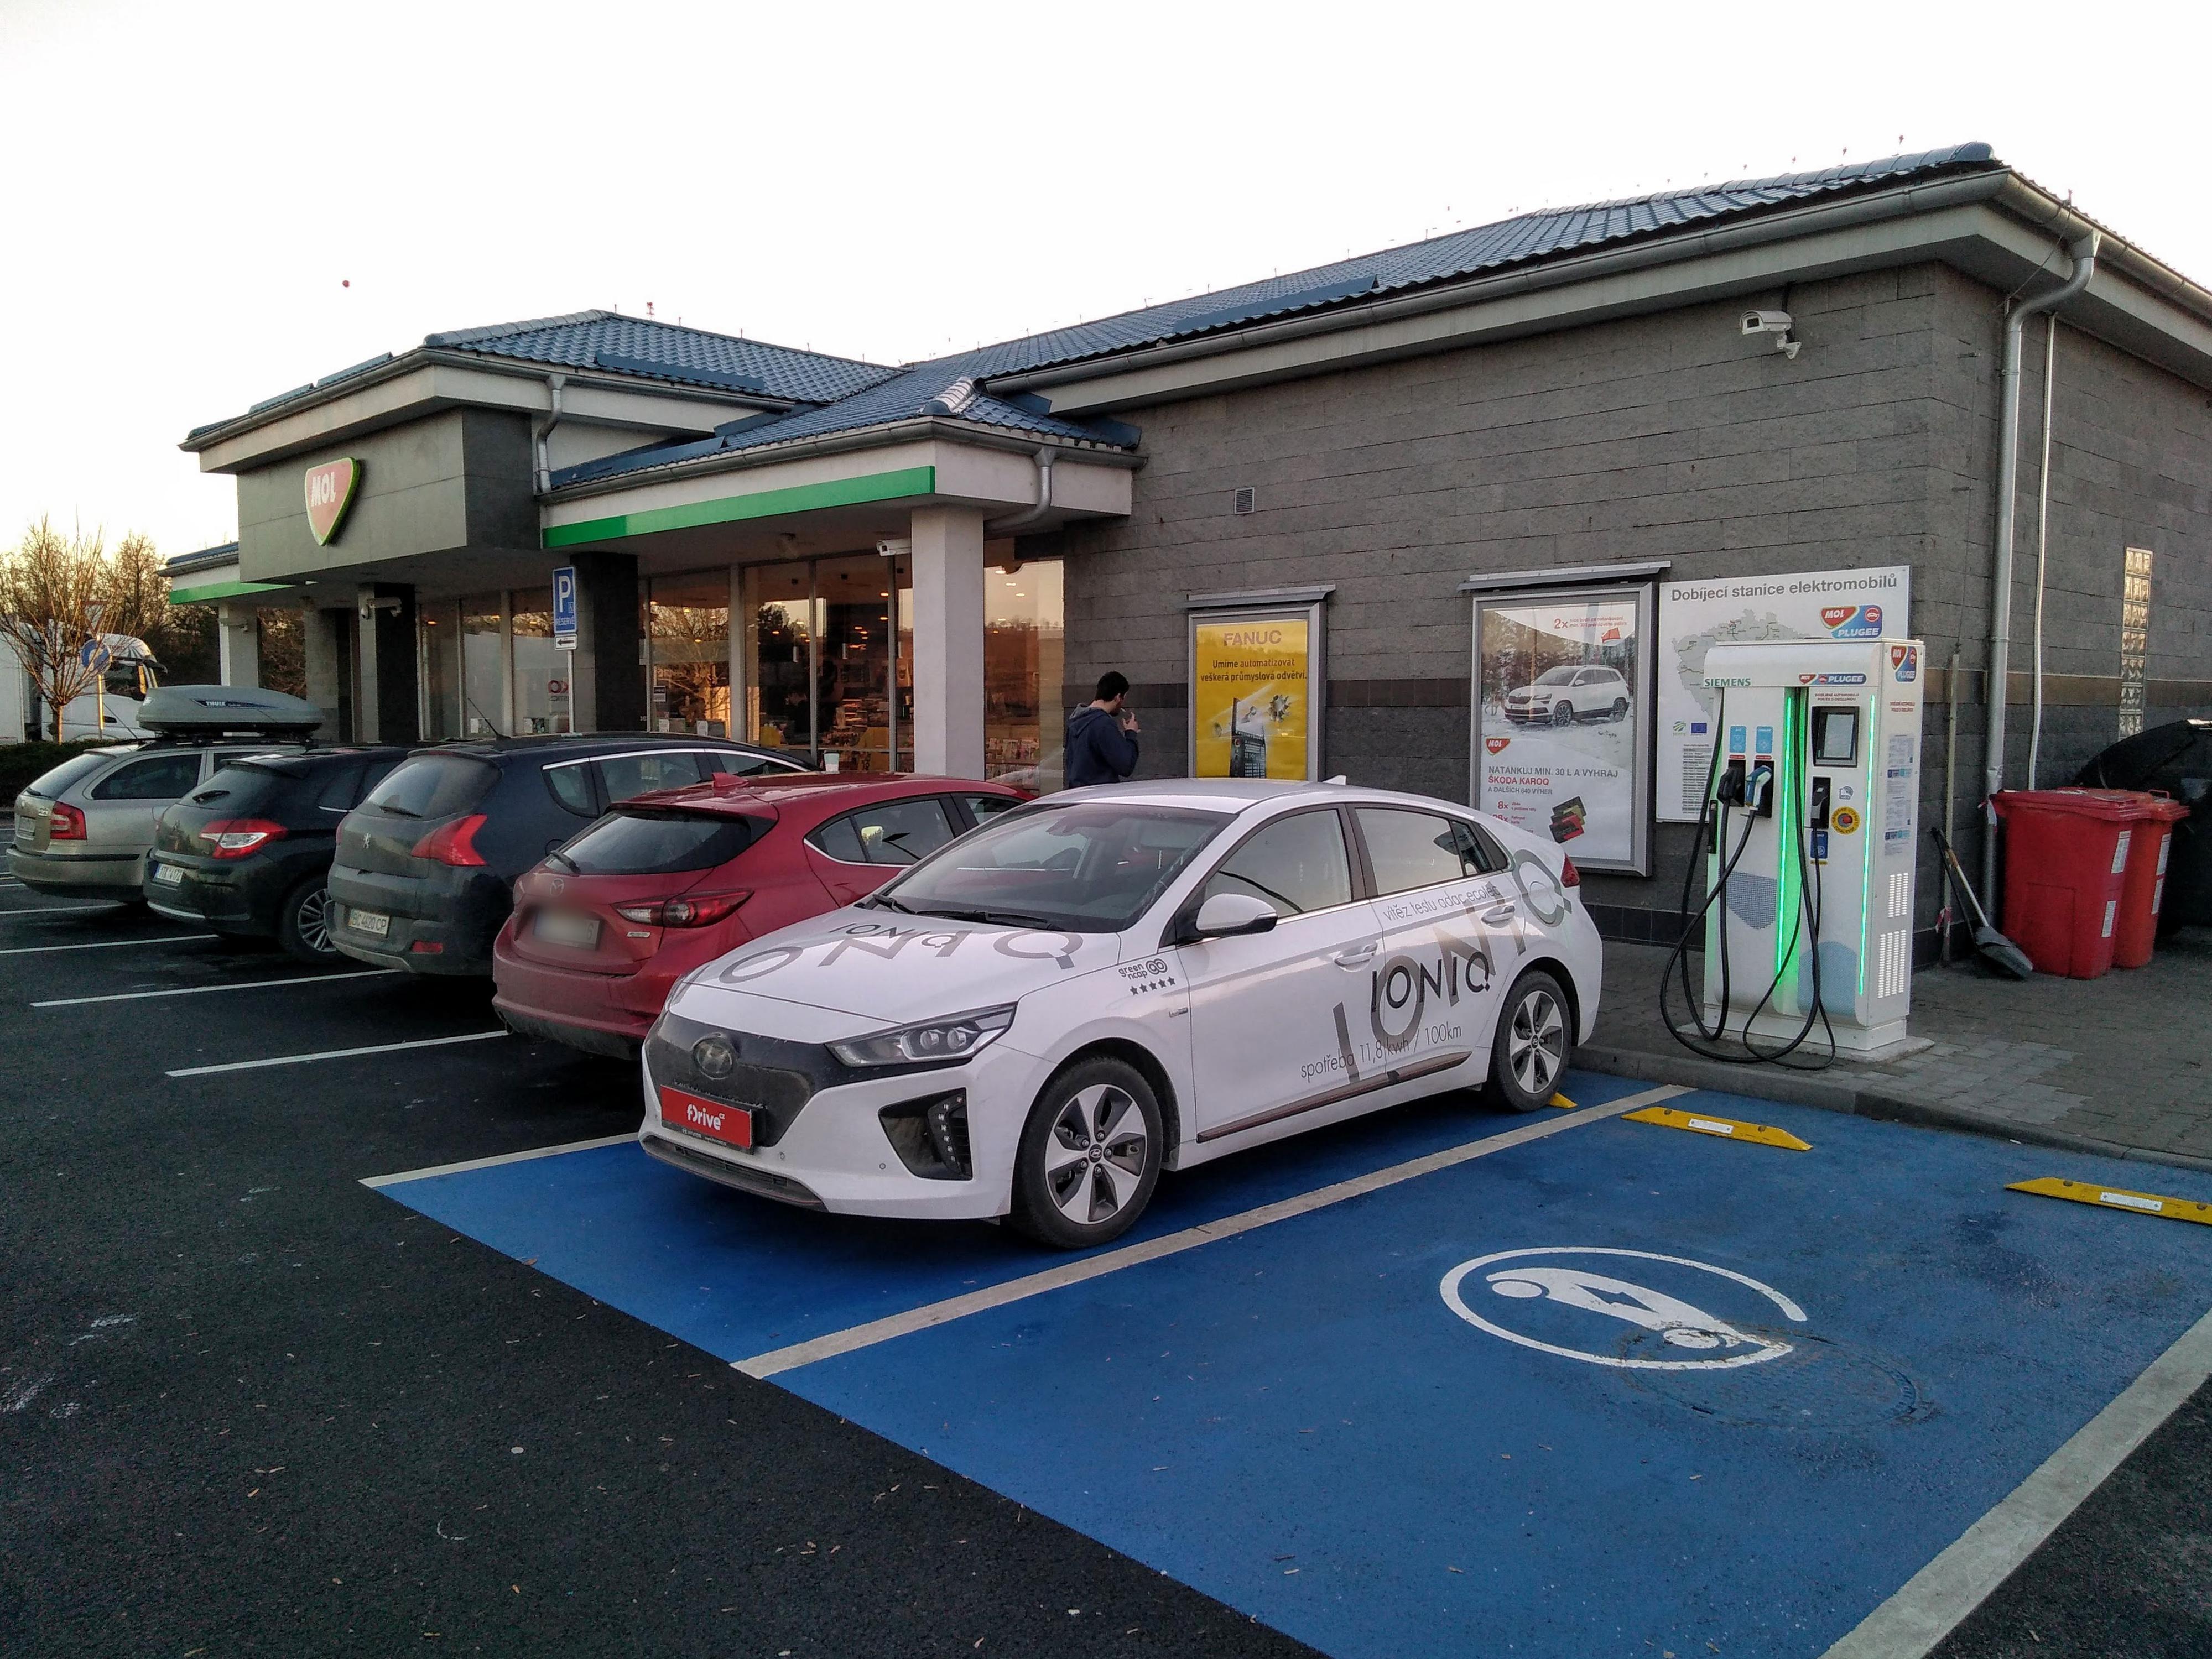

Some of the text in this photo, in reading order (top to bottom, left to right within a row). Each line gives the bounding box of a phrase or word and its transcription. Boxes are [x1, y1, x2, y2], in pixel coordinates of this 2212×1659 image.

[311, 472, 336, 507] MOL
[1671, 573, 1897, 601] Dobíjecí stanice elektromobilů
[559, 576, 571, 613] P
[1825, 610, 1844, 618] MOL
[1554, 618, 1568, 629] 2x
[1224, 630, 1282, 646] FANUC
[1838, 628, 1880, 637] PLUGEE
[1212, 658, 1295, 669] Umíme automatizovat
[1200, 670, 1307, 682] veškerá průmyslová odvětví.
[1898, 670, 1916, 679] PLUGEE
[1704, 678, 1751, 687] SIEMENS
[1488, 766, 1532, 775] NATANKUJ
[1534, 767, 1553, 775] MIN.
[1583, 769, 1618, 778] VYHRAJ
[1488, 775, 1549, 786] ŠKODA KAROQ
[1498, 801, 1509, 810] 8x
[1383, 904, 1412, 921] vítěz
[1409, 900, 1437, 915] testu
[1438, 890, 1466, 909] adac
[828, 922, 959, 948] IONIQ
[1118, 963, 1144, 978] green
[1127, 970, 1148, 980] ncap
[1371, 951, 1491, 1013] IONIQ
[1300, 1021, 1461, 1083] spotřeba 11,8 kwh / 100km
